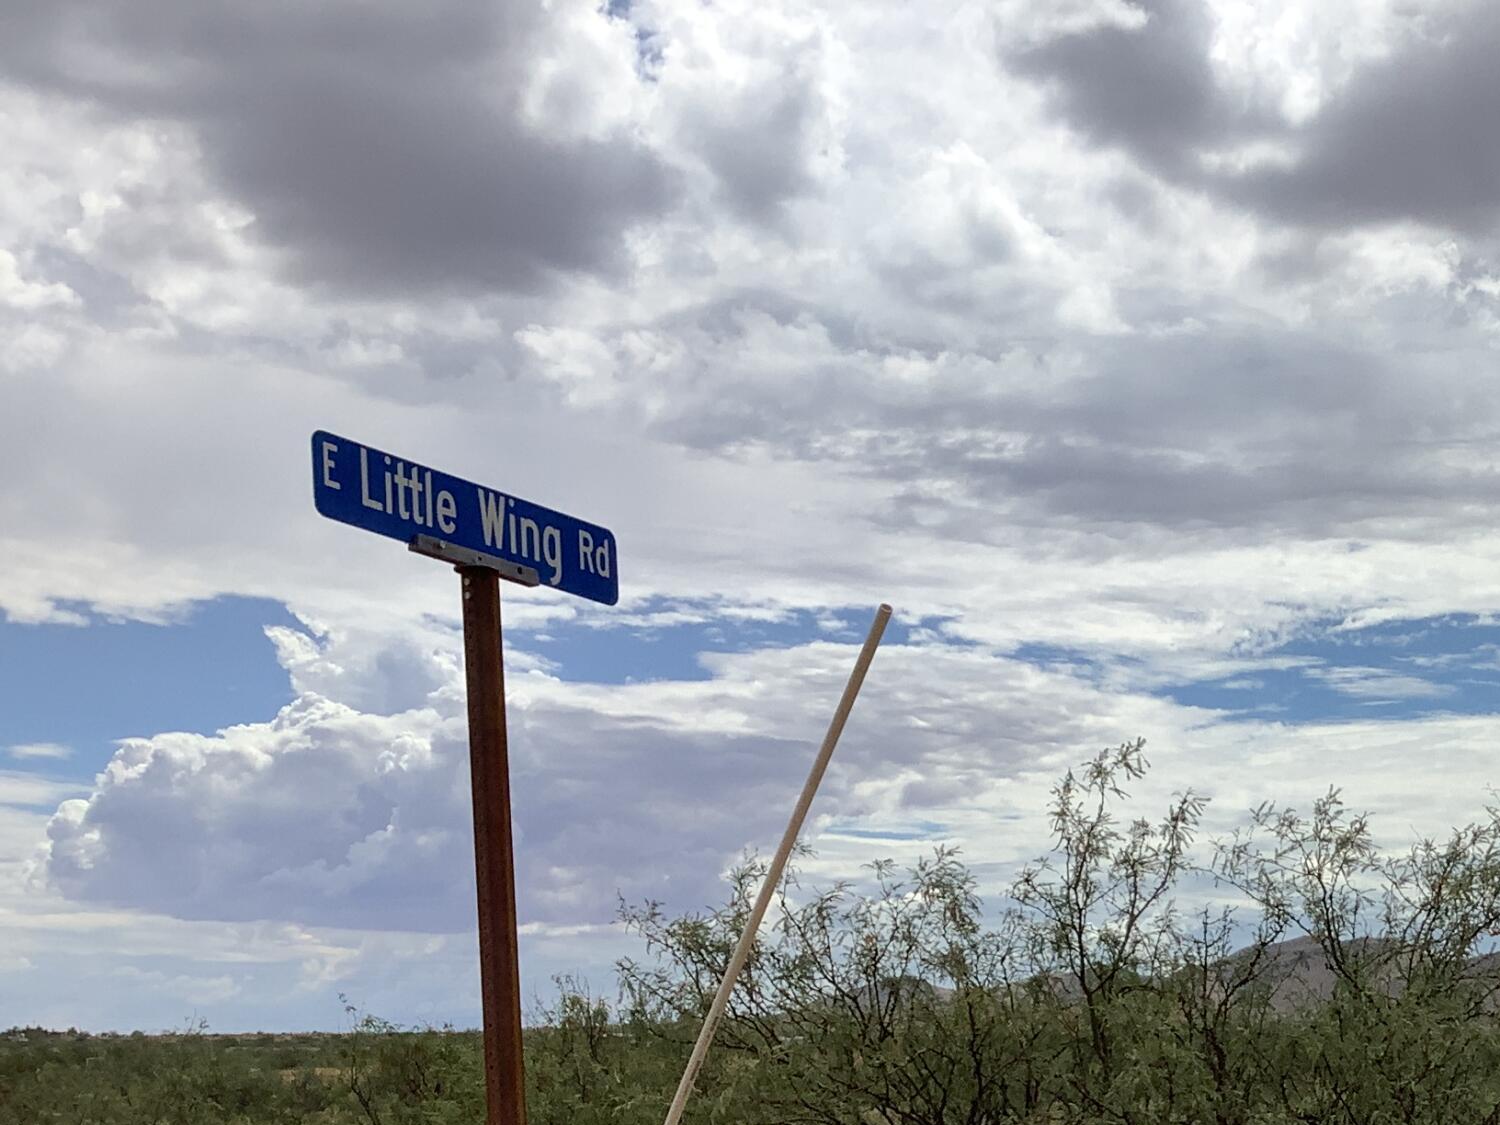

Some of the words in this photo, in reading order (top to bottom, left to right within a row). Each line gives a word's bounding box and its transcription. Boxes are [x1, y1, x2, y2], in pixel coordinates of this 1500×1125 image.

[322, 441, 341, 491] E
[360, 447, 457, 535] Little
[477, 487, 563, 586] Wing
[578, 528, 610, 579] Rd
